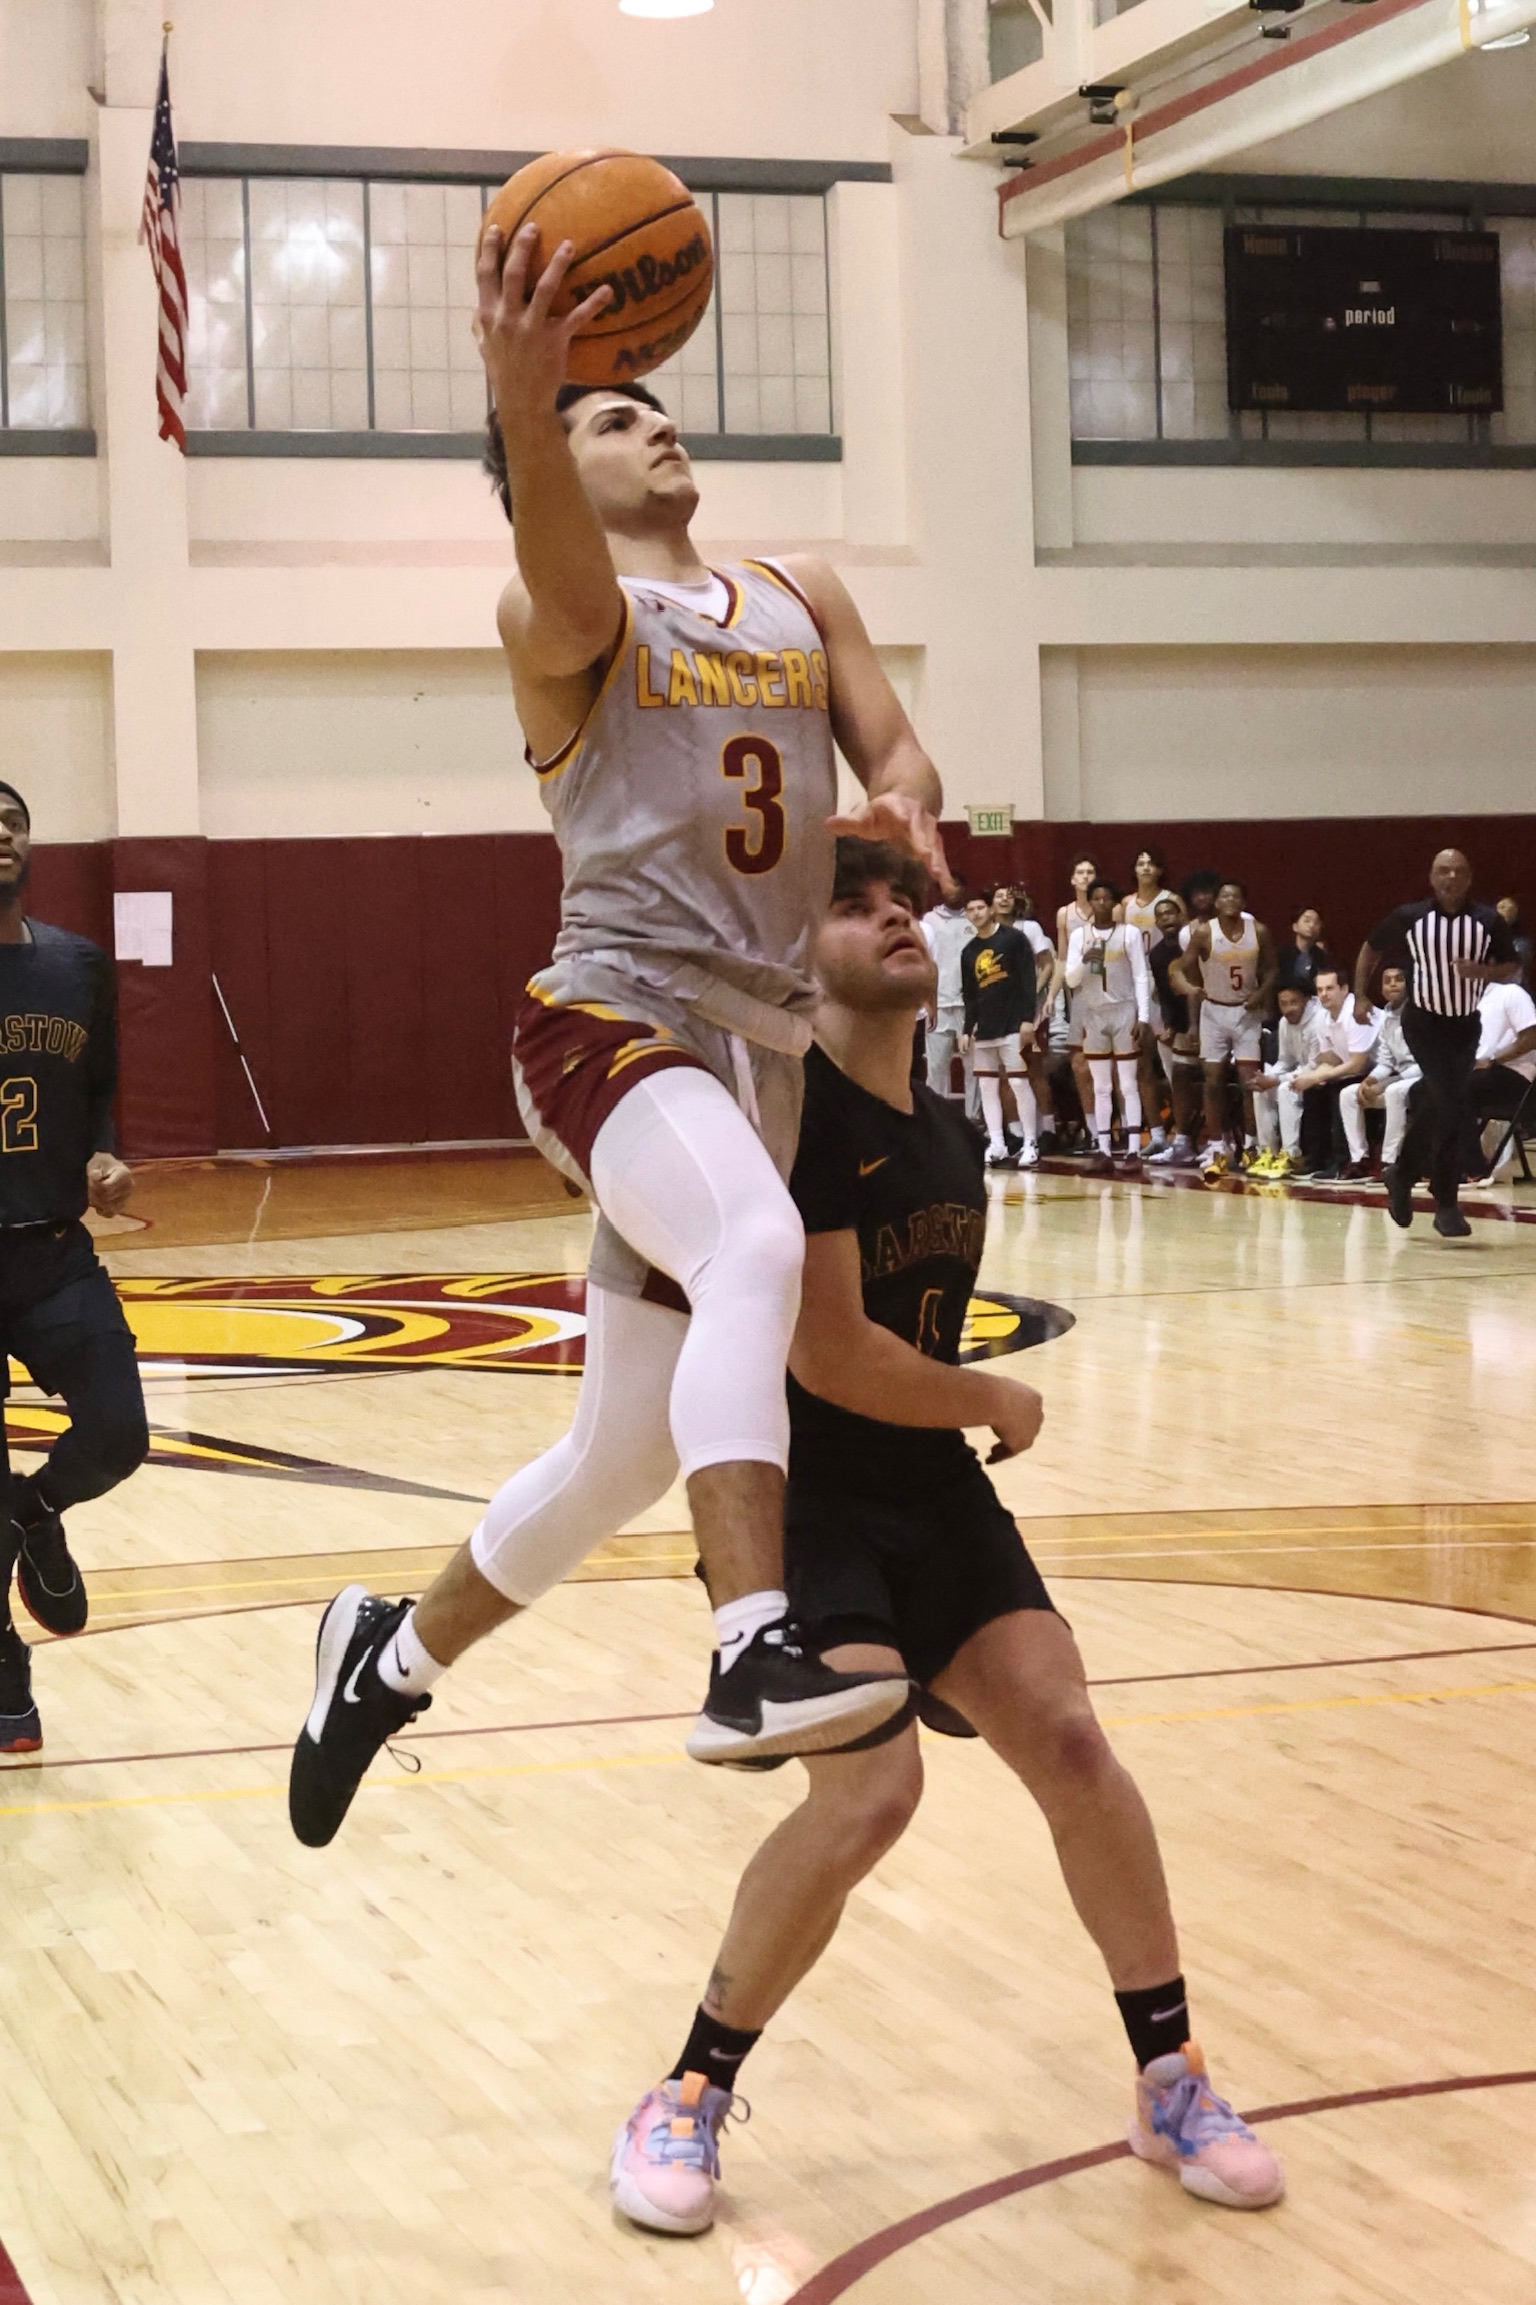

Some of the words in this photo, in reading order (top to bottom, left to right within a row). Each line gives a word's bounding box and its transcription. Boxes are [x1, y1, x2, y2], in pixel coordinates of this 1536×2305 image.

[1345, 307, 1395, 327] period
[636, 644, 829, 711] LANCERS
[722, 732, 787, 876] 3
[978, 812, 1003, 831] EXIT
[1230, 966, 1243, 991] 5
[0, 1013, 88, 1062] STOW
[0, 1077, 38, 1152] 2
